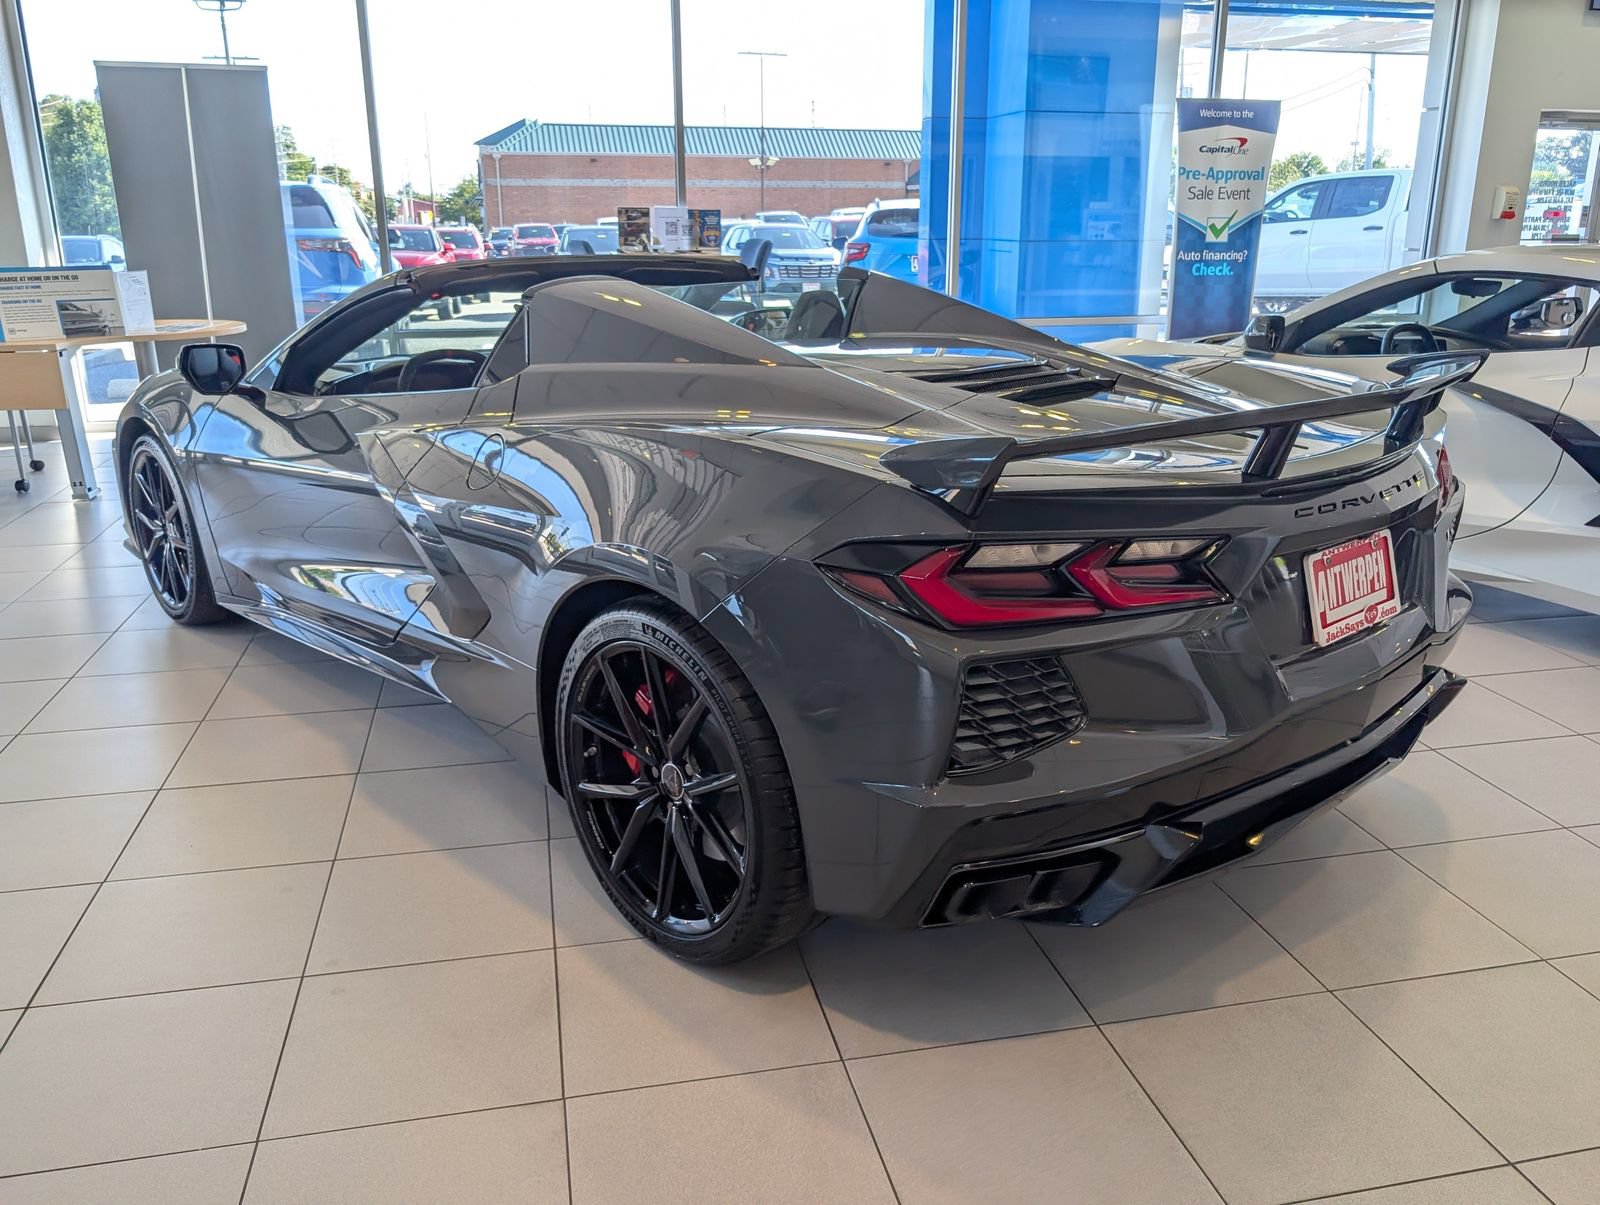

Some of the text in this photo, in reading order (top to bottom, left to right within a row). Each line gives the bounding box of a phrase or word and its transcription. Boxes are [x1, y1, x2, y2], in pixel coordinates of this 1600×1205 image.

[1200, 109, 1254, 118] Welcome to the
[1179, 166, 1265, 184] Pre-Approval
[1187, 185, 1251, 201] Sale Event
[1177, 249, 1248, 263] Auto financing?
[1192, 262, 1234, 276] Check.
[1294, 471, 1425, 519] CORVETTE
[1314, 548, 1387, 613] ANTWERPEN
[654, 630, 708, 683] MICHELIN
[711, 687, 728, 714] PILOT
